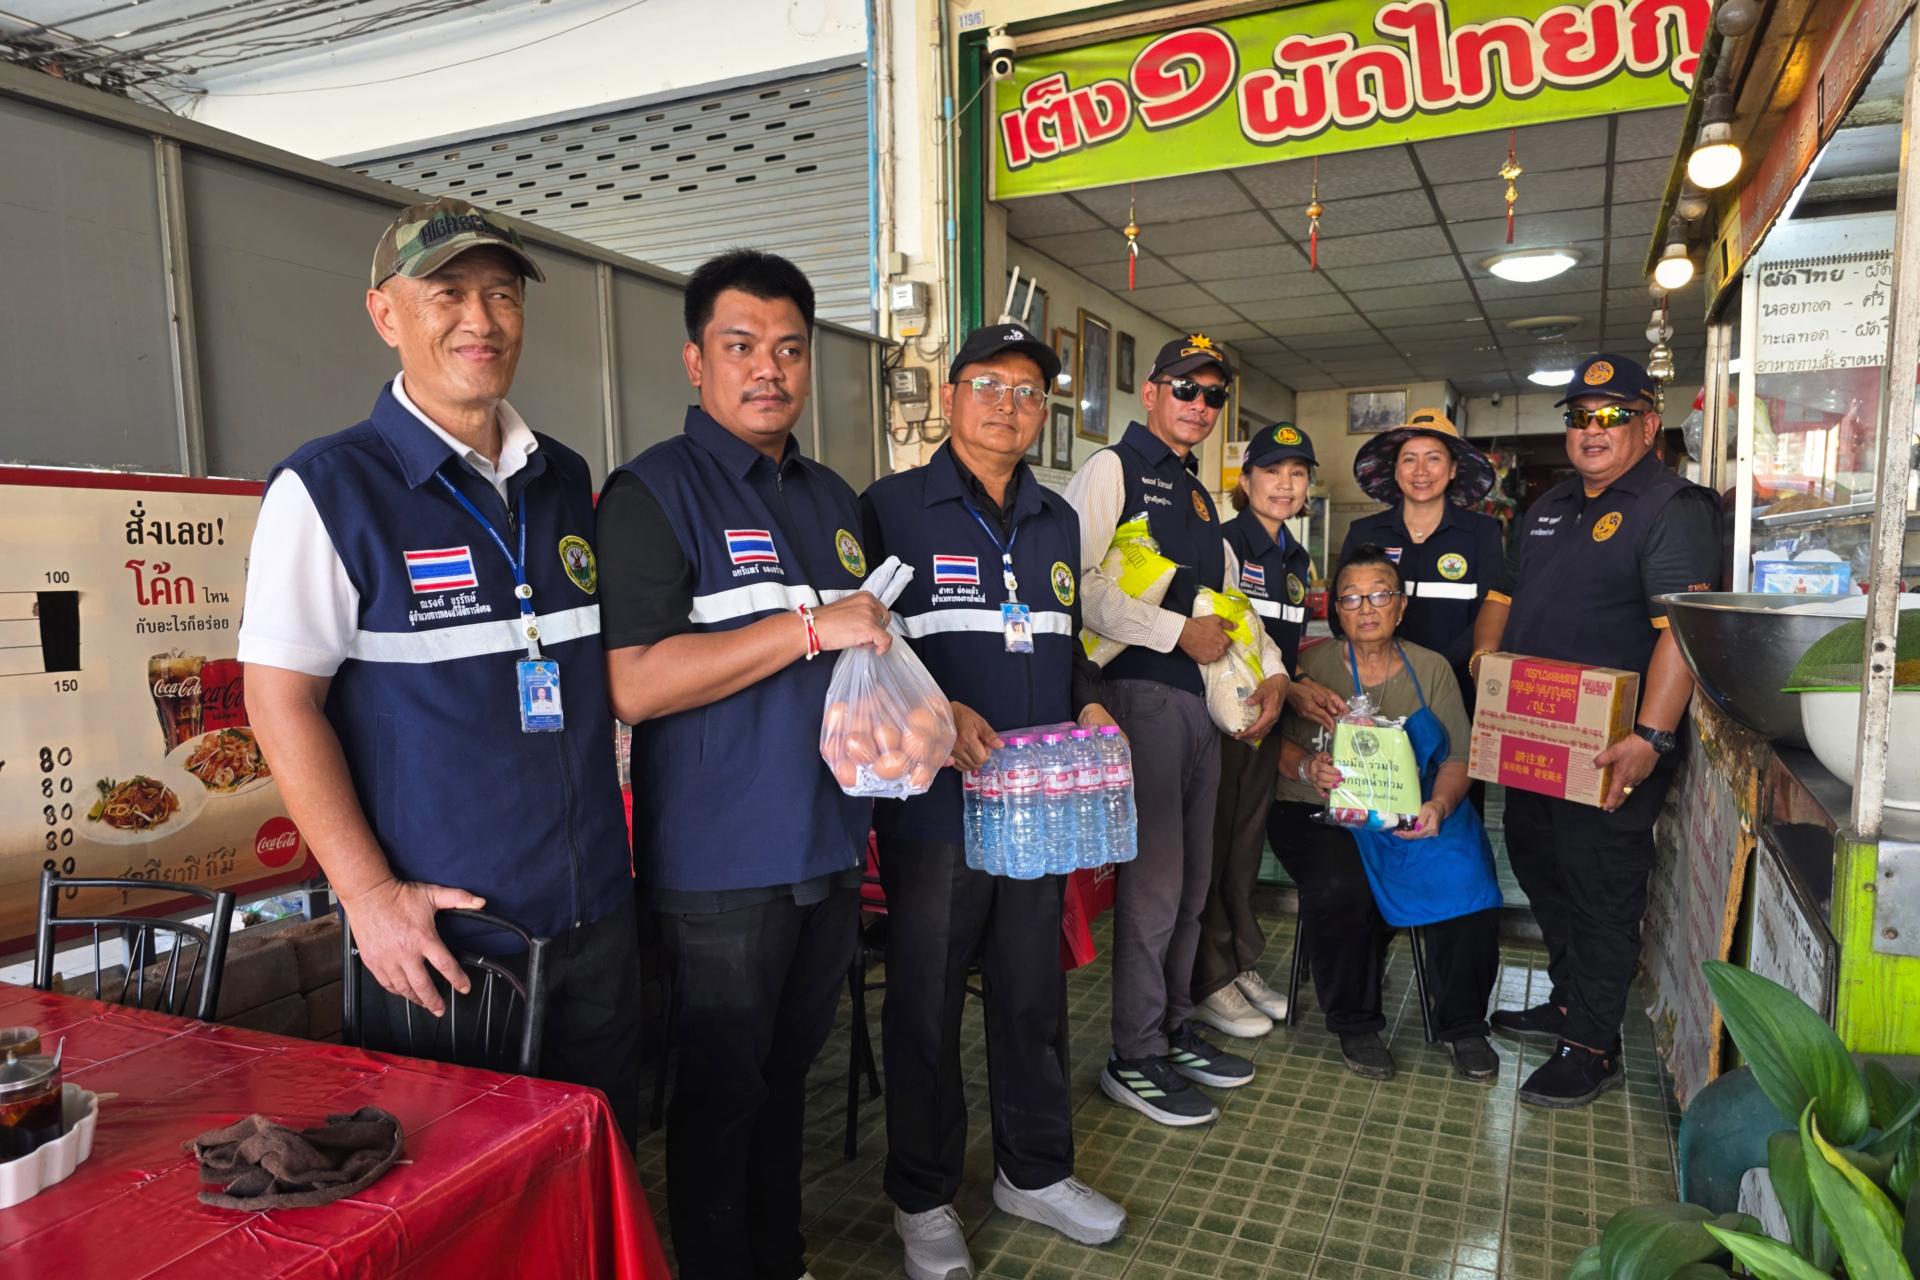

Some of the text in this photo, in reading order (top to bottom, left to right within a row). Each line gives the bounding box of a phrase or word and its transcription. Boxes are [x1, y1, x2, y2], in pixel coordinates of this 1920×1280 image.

[1763, 267, 1845, 287] ผัดไทย
[1762, 300, 1831, 317] หอยทอด
[1762, 329, 1829, 345] ทะเลทอด
[125, 501, 225, 546] สั่งเลย!
[44, 571, 70, 584] 100
[125, 559, 229, 606] โค้ก ไหน
[420, 595, 445, 609] ณรงค์
[136, 615, 229, 634] กับอะไรก็อร่อย
[53, 680, 79, 693] 150
[40, 746, 72, 773] 80
[41, 776, 73, 798] 80
[43, 802, 72, 826] 80
[46, 828, 73, 851] 80
[257, 830, 298, 854] Coca-Cola
